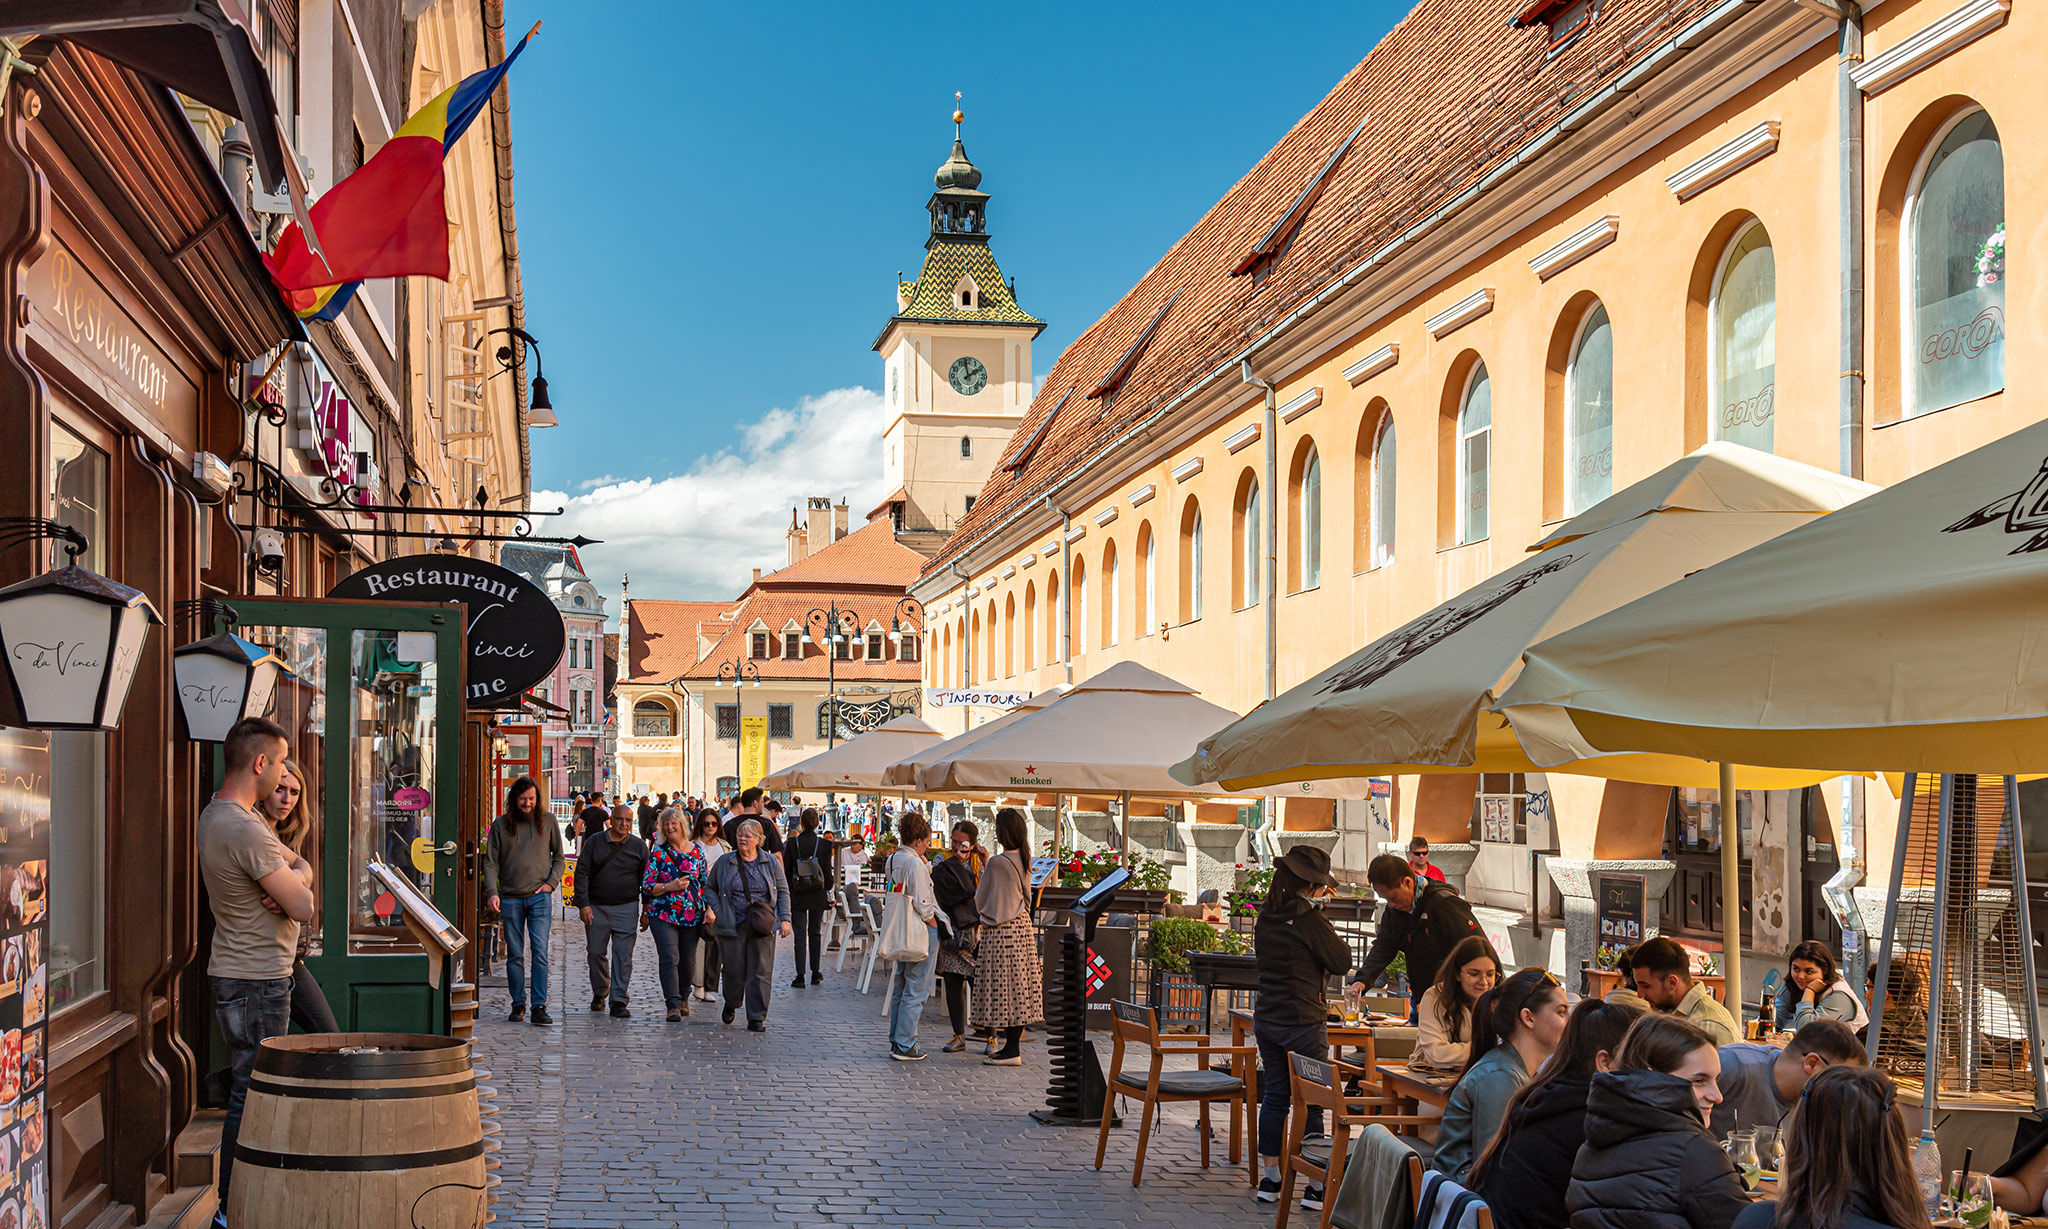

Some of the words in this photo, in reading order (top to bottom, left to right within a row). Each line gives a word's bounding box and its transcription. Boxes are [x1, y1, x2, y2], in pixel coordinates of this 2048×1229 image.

[52, 249, 168, 410] Restaurant
[364, 567, 519, 603] Restaurant
[33, 651, 51, 669] da
[984, 694, 1024, 706] TOURS
[1010, 777, 1052, 785] Heineken
[1369, 782, 1389, 794] RISM
